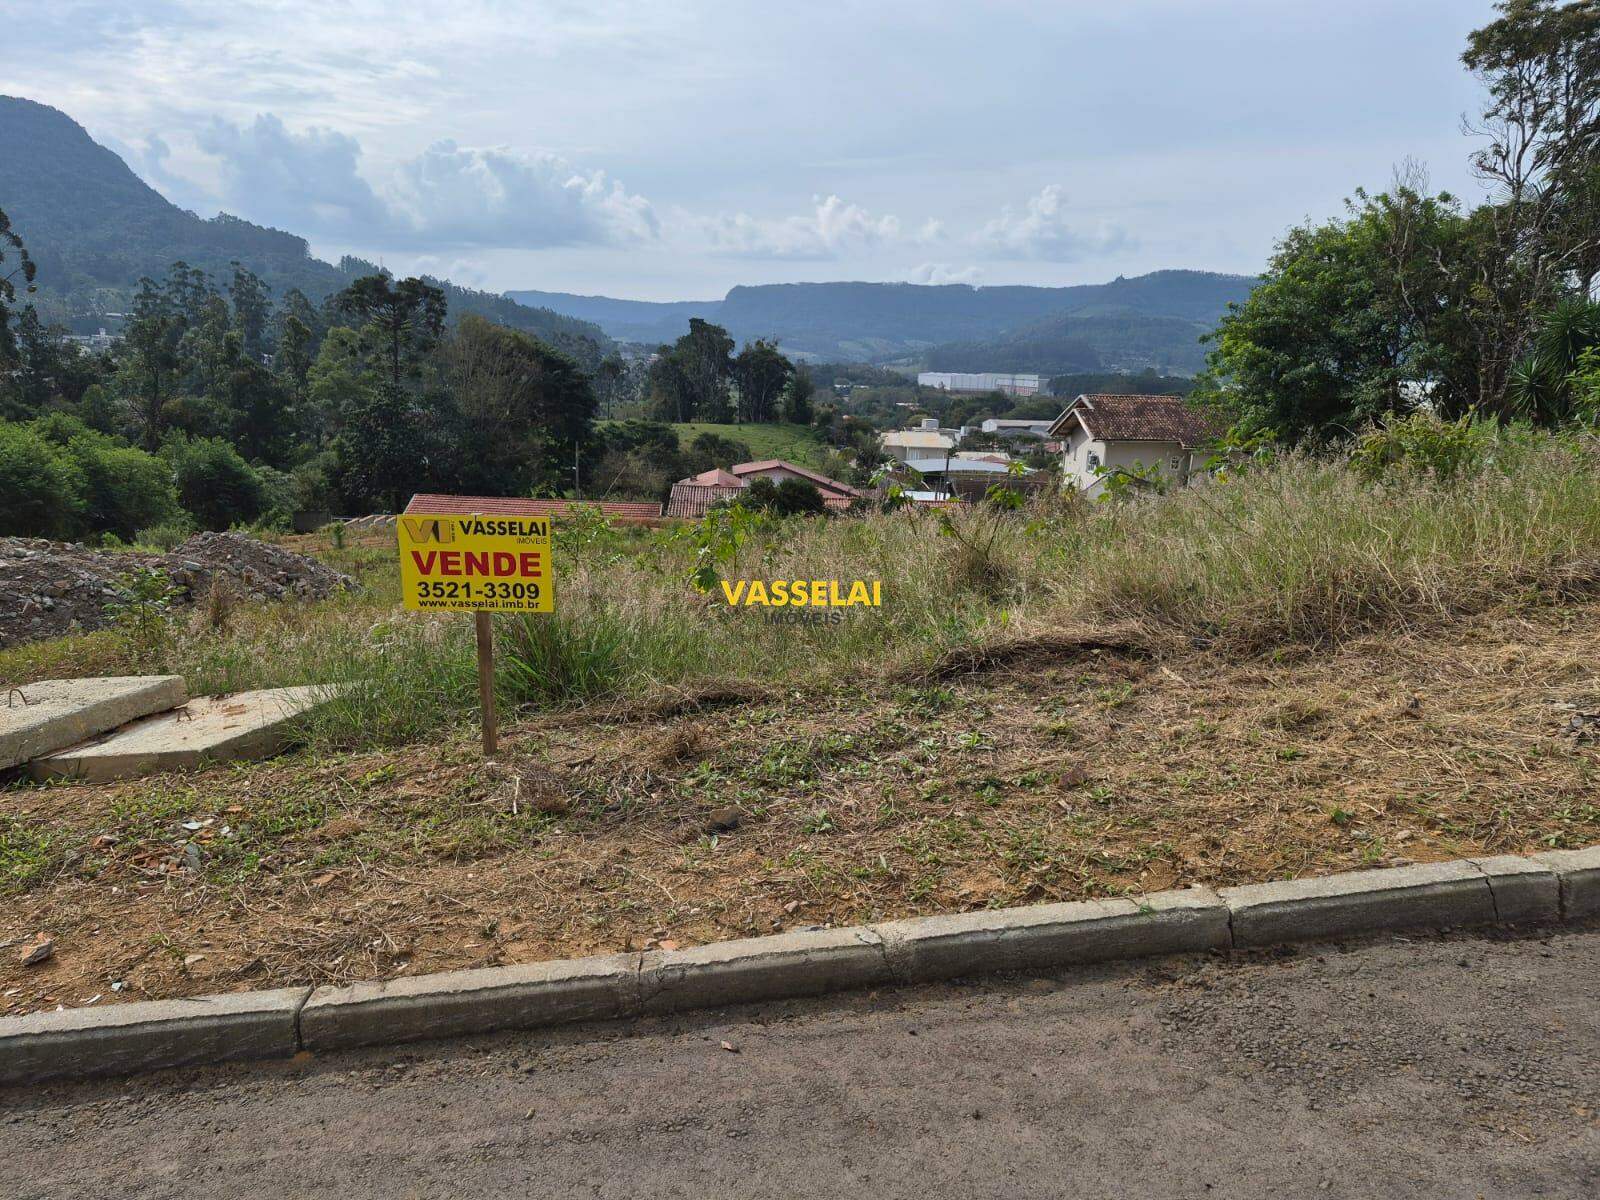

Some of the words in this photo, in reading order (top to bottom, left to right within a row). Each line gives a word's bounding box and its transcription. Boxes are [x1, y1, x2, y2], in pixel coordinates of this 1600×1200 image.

[459, 521, 547, 536] VASSELAI
[411, 551, 542, 577] VENDE
[417, 582, 540, 599] 3521-3309
[419, 600, 540, 609] www.vasselai.imb.br
